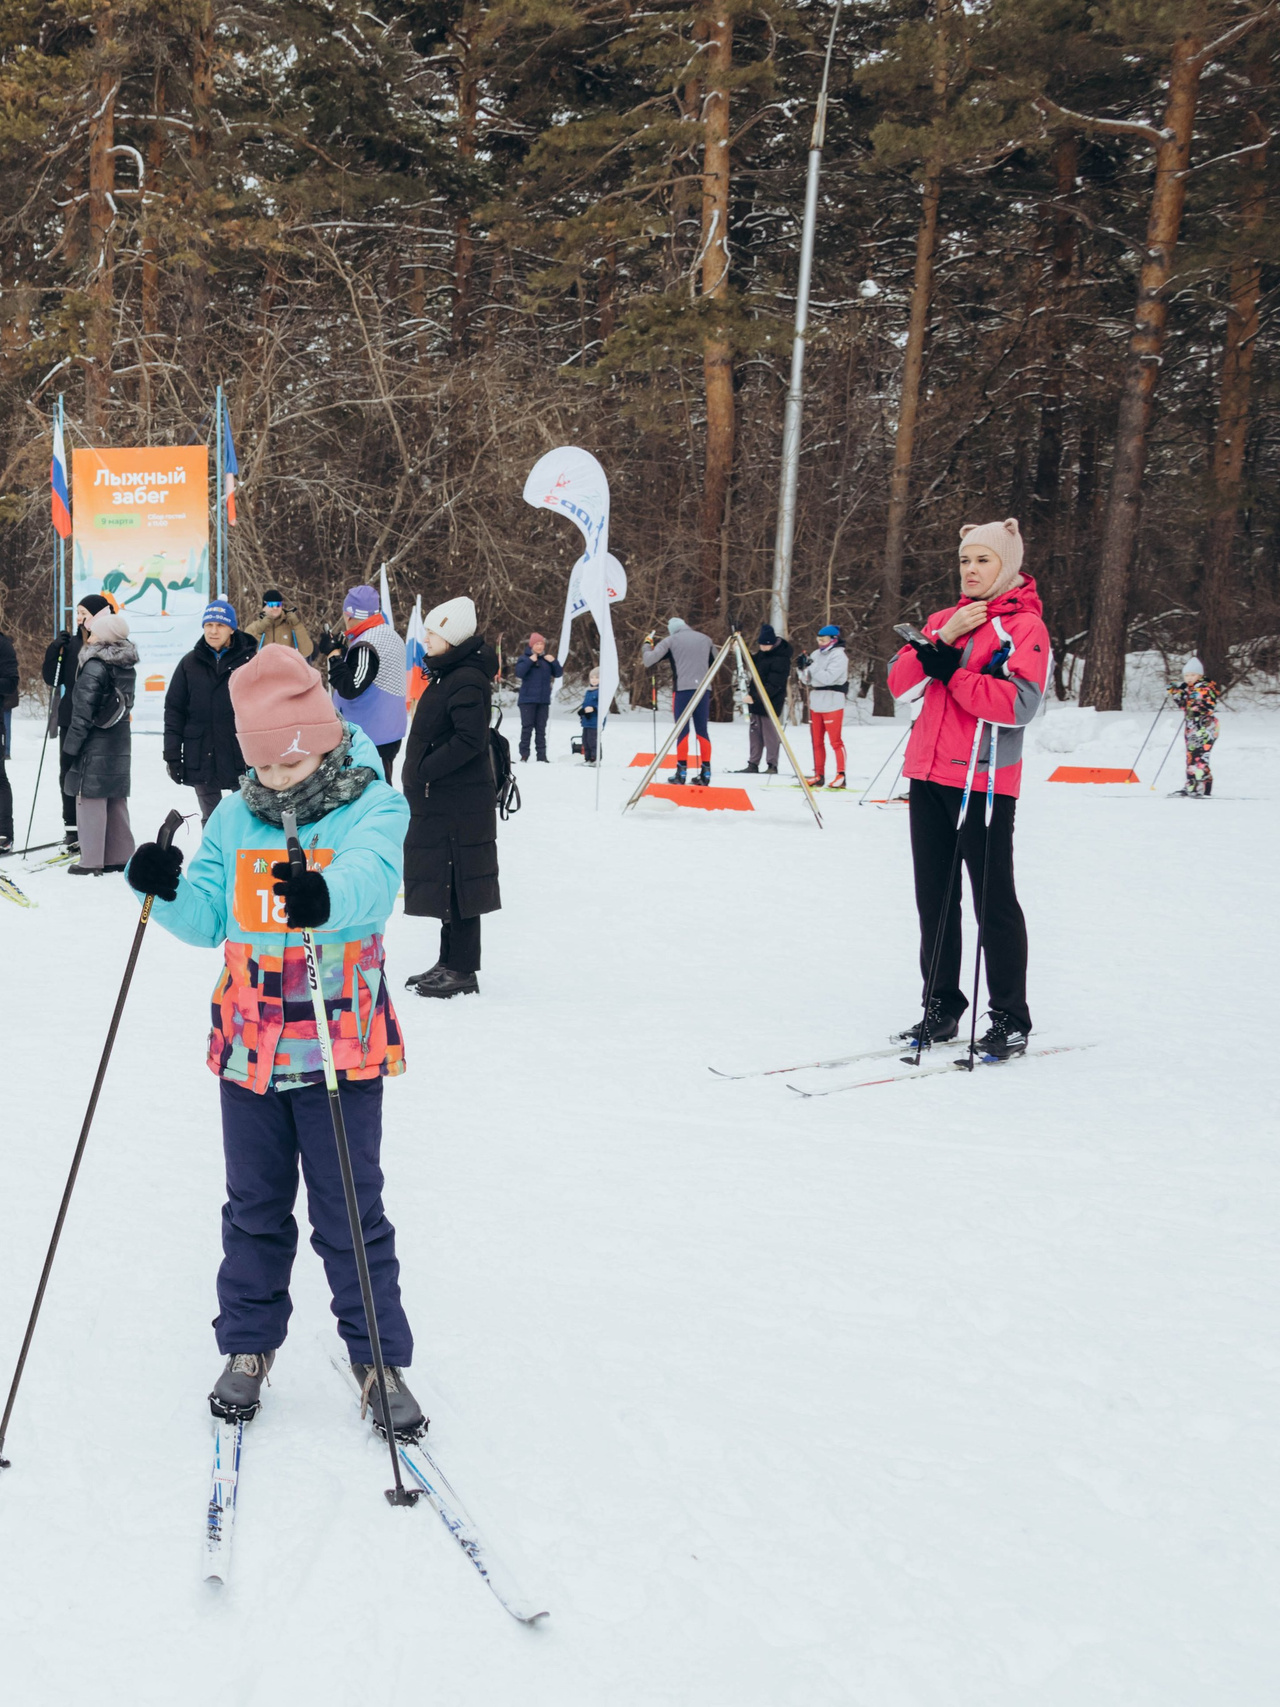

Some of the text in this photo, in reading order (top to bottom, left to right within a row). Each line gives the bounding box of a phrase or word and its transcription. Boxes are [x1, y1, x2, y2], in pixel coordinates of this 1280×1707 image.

[94, 466, 186, 486] Лыжный
[112, 486, 169, 505] забег
[108, 518, 134, 526] марта
